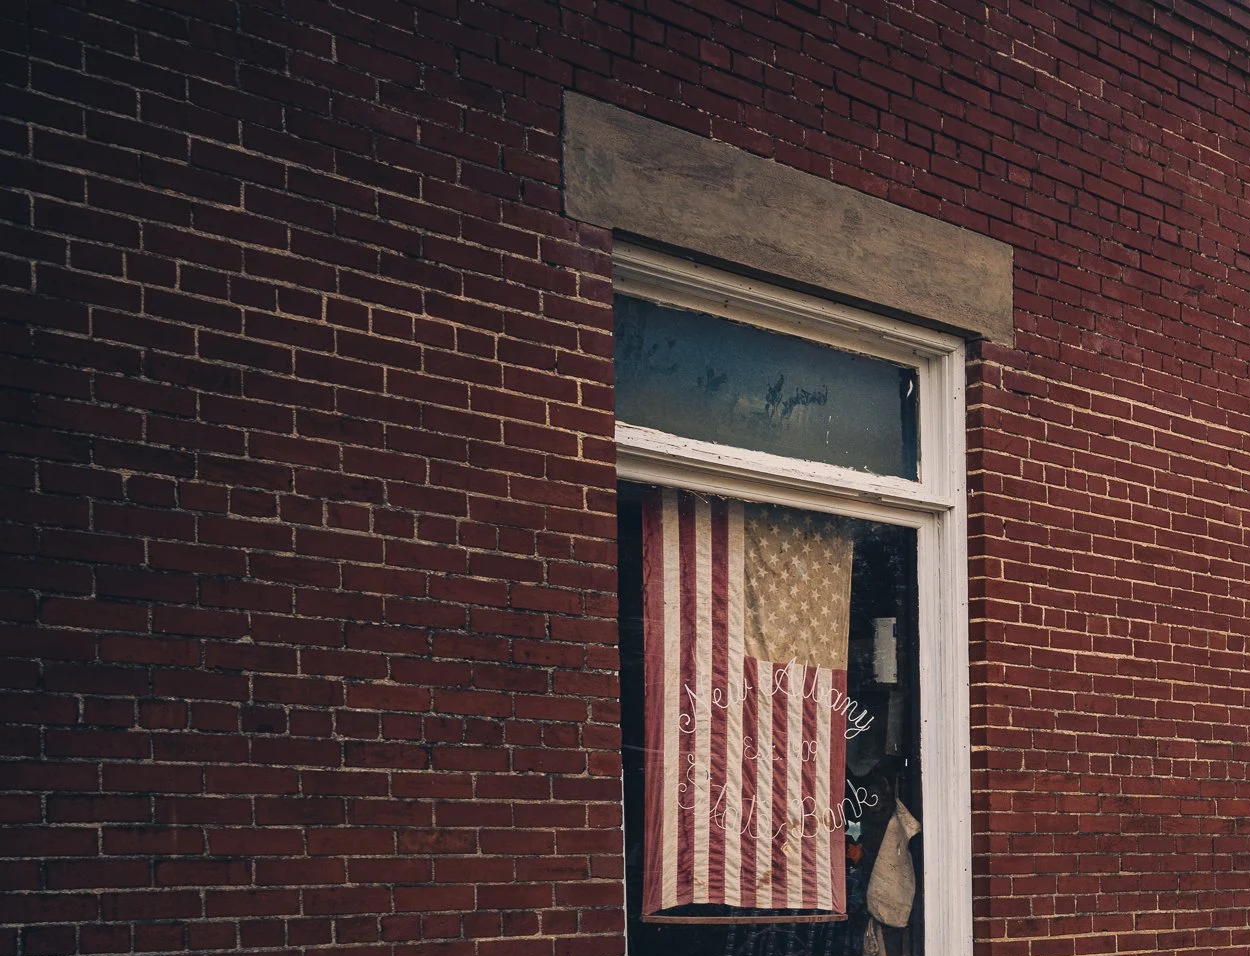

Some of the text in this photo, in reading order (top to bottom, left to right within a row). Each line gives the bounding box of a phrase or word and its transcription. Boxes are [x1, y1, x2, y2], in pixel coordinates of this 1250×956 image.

[678, 656, 875, 740] New Albany
[788, 739, 819, 762] 909
[790, 778, 879, 839] Bank
